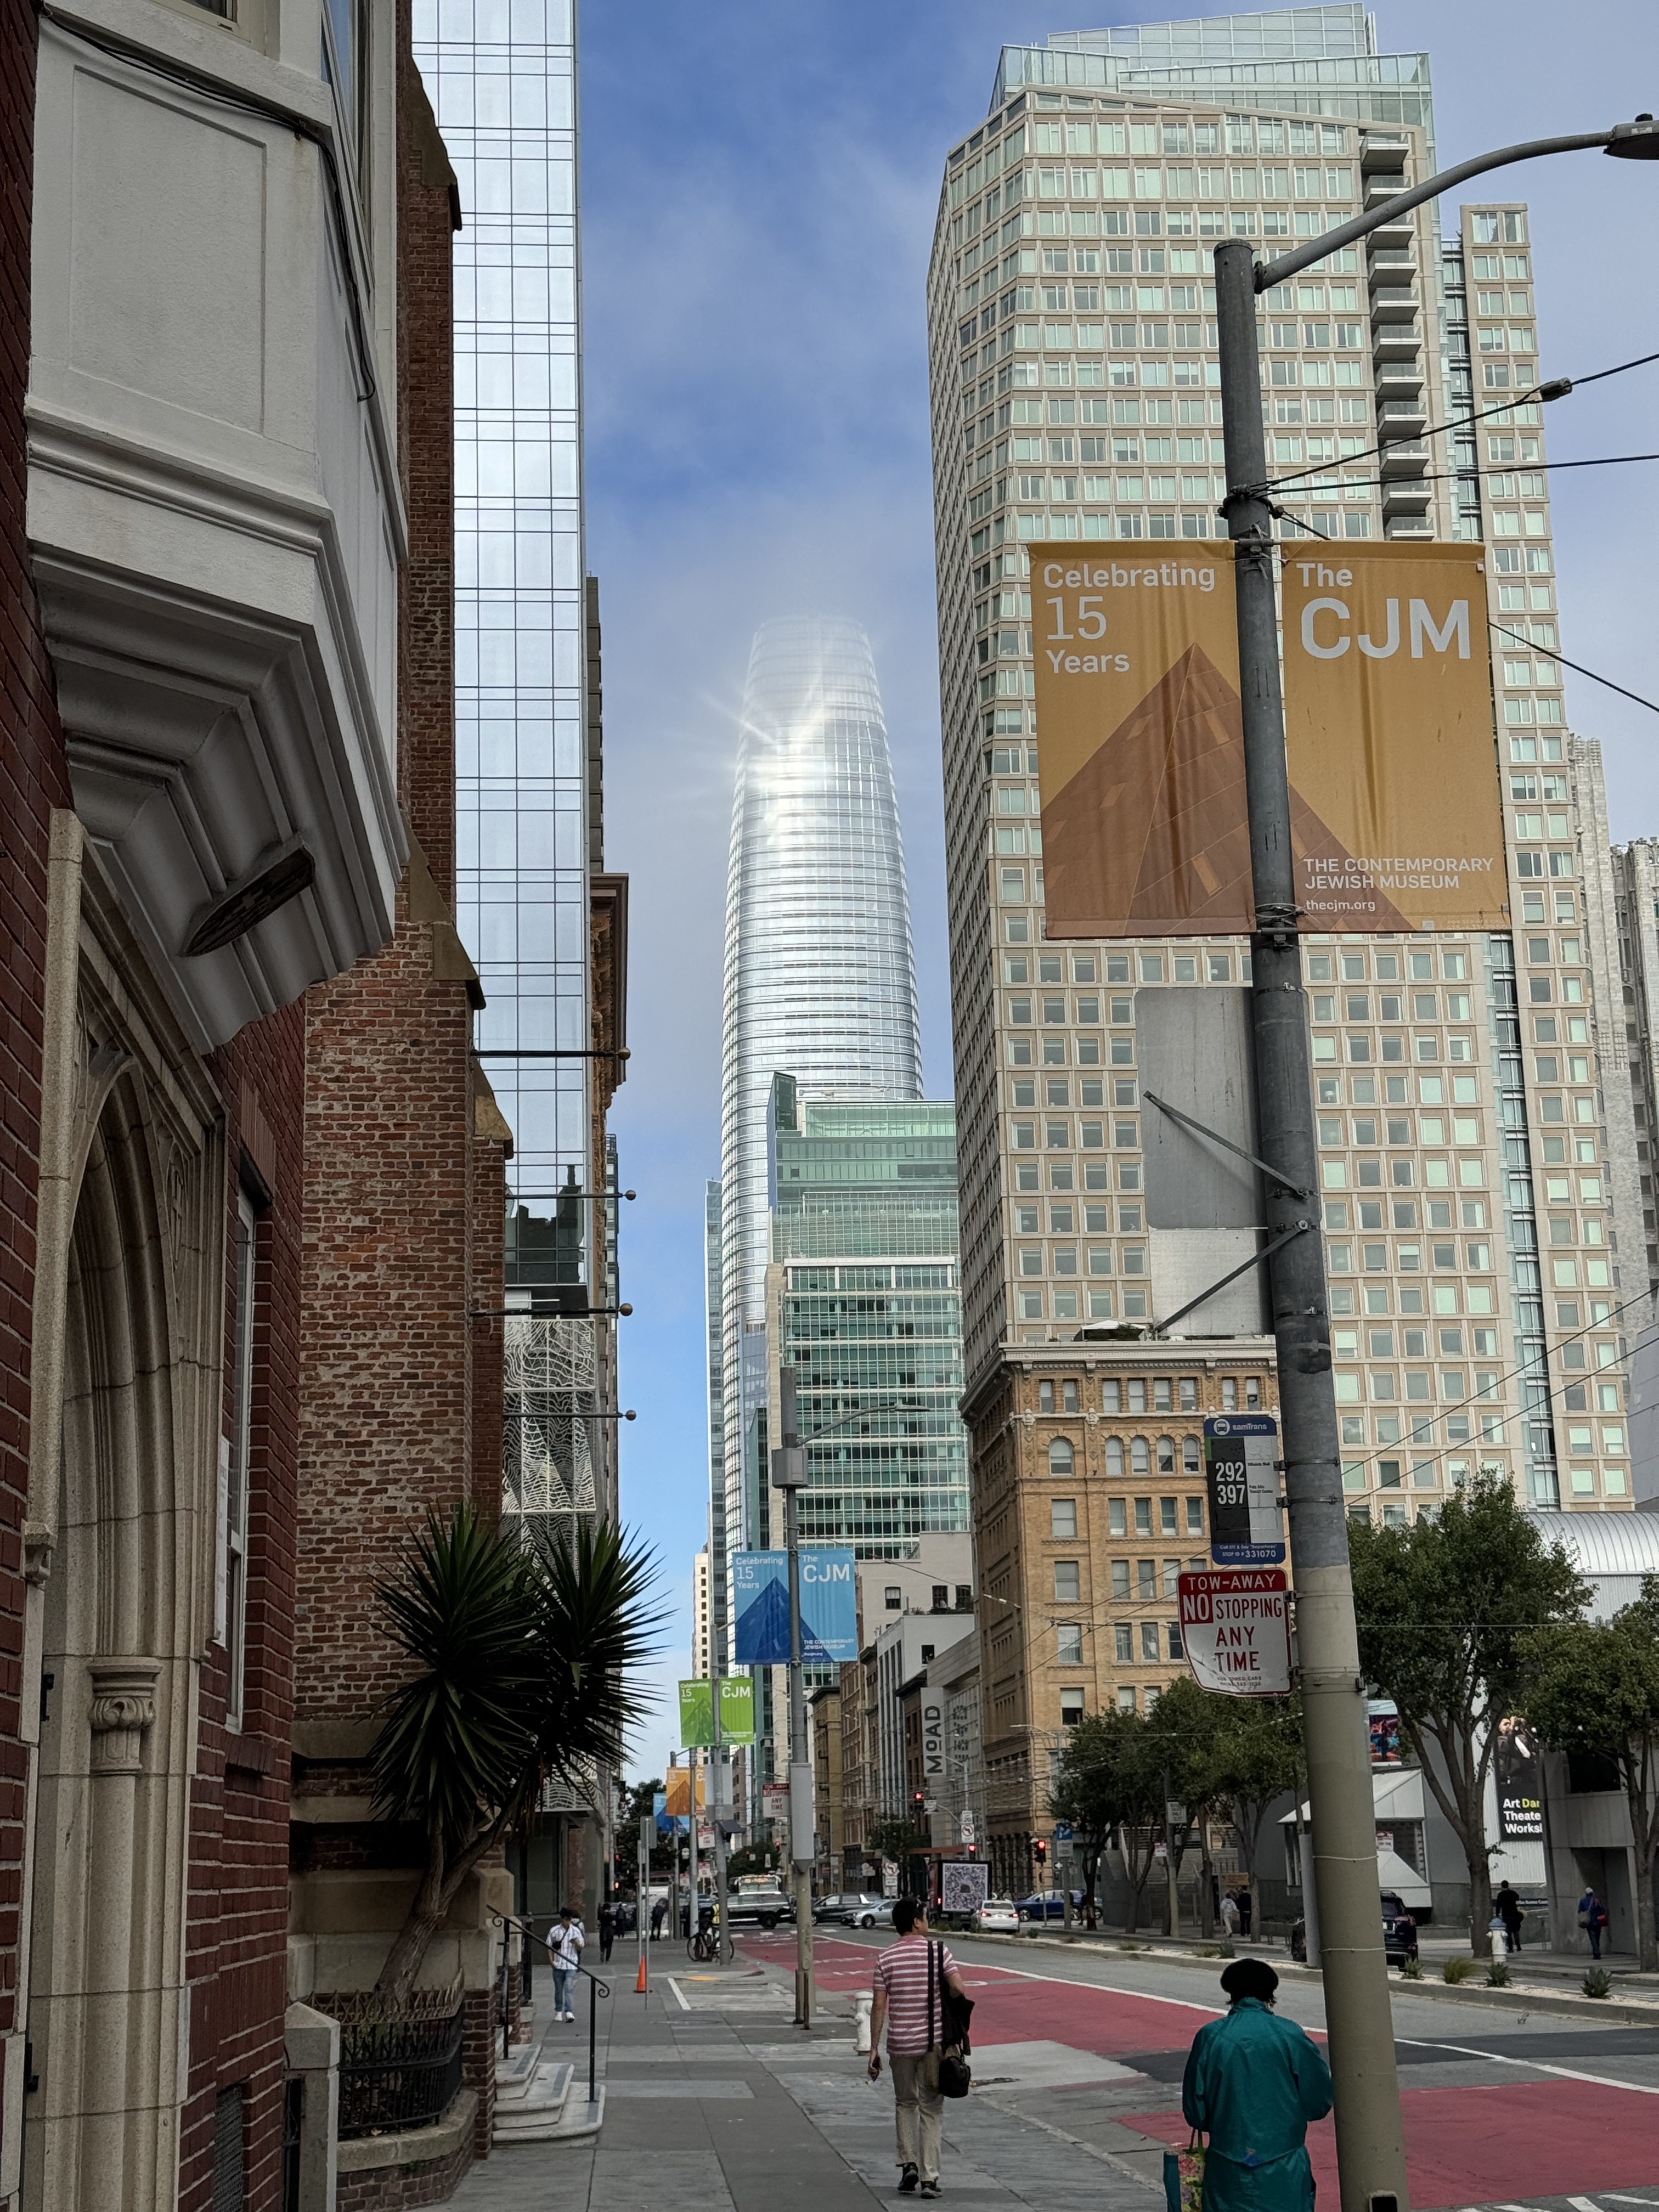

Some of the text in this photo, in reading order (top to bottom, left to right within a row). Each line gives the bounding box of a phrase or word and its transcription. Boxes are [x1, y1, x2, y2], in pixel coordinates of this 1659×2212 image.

[1043, 562, 1216, 592] Celebrating
[1296, 562, 1353, 588] The
[1046, 595, 1107, 640] 15
[1300, 597, 1471, 660] CJM
[1046, 649, 1130, 674] Years
[1304, 857, 1494, 873] THE CONTEMPORARY
[1305, 874, 1460, 890] JEWISH MUSEUM
[1306, 898, 1376, 912] thecjm.org
[1215, 1462, 1245, 1482] 292
[1217, 1485, 1246, 1505] 397
[736, 1556, 783, 1566] Celebrating
[802, 1554, 818, 1563] The
[1245, 1550, 1276, 1558] 331070
[736, 1566, 754, 1579] 15
[803, 1563, 850, 1583] CJM
[1187, 1573, 1276, 1590] TOW-AWAY
[1183, 1593, 1283, 1621] NO STOPPING
[1215, 1626, 1255, 1647] ANY
[1215, 1651, 1261, 1672] TIME
[681, 1688, 692, 1697] 15
[721, 1686, 751, 1699] CJM
[1503, 1798, 1521, 1809] Art
